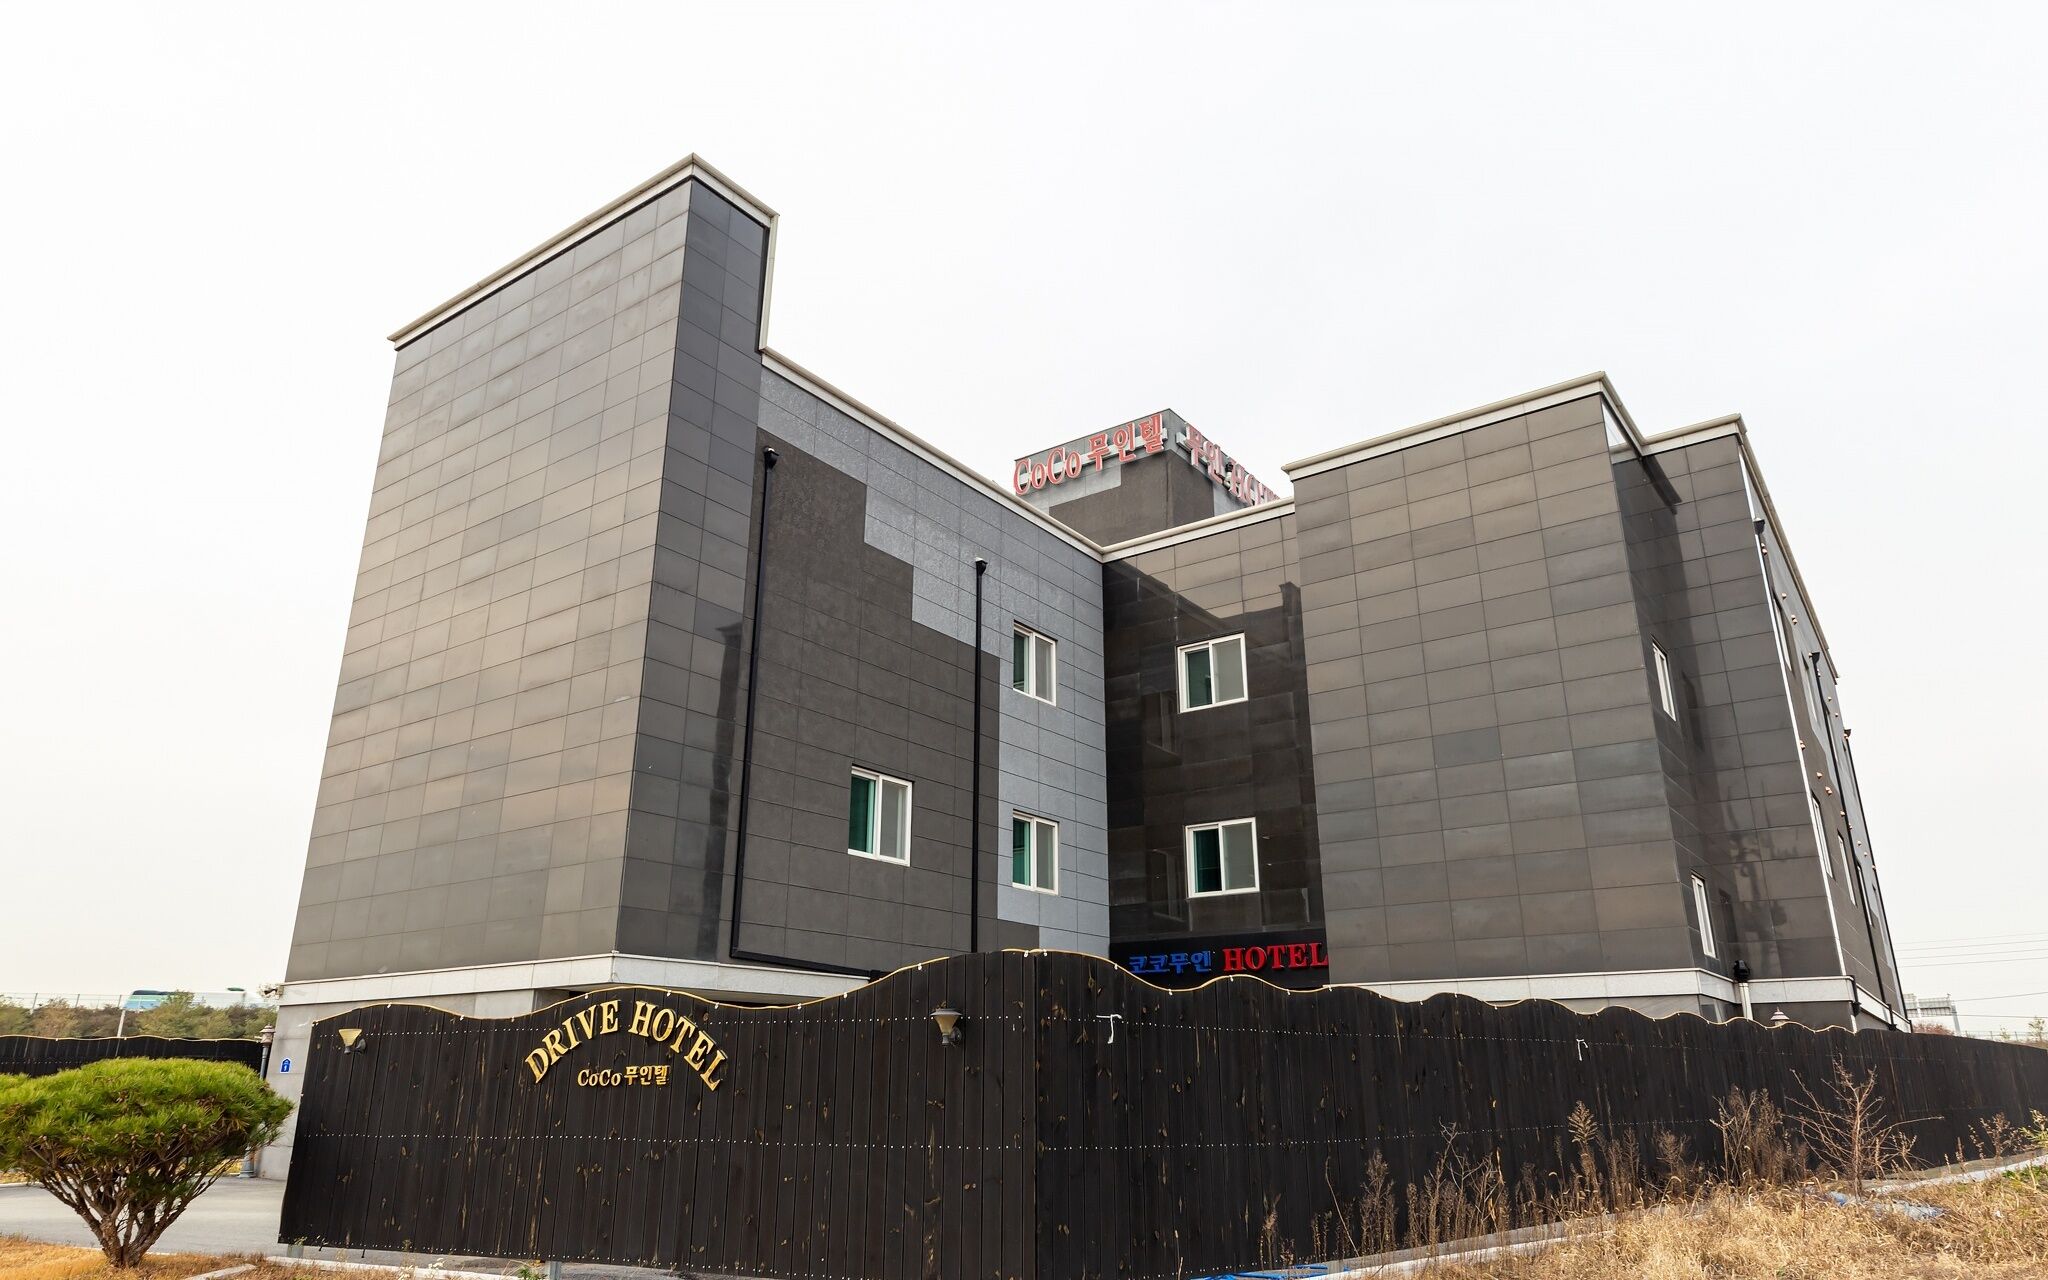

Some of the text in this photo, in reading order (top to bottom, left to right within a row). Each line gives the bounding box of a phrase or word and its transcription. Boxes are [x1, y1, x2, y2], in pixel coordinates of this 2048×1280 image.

[1014, 413, 1164, 496] CoCo 무인텔
[1223, 942, 1328, 971] HOTEL
[525, 999, 728, 1091] DRIVE HOTEL
[578, 1065, 670, 1087] CoCo 무인텔
